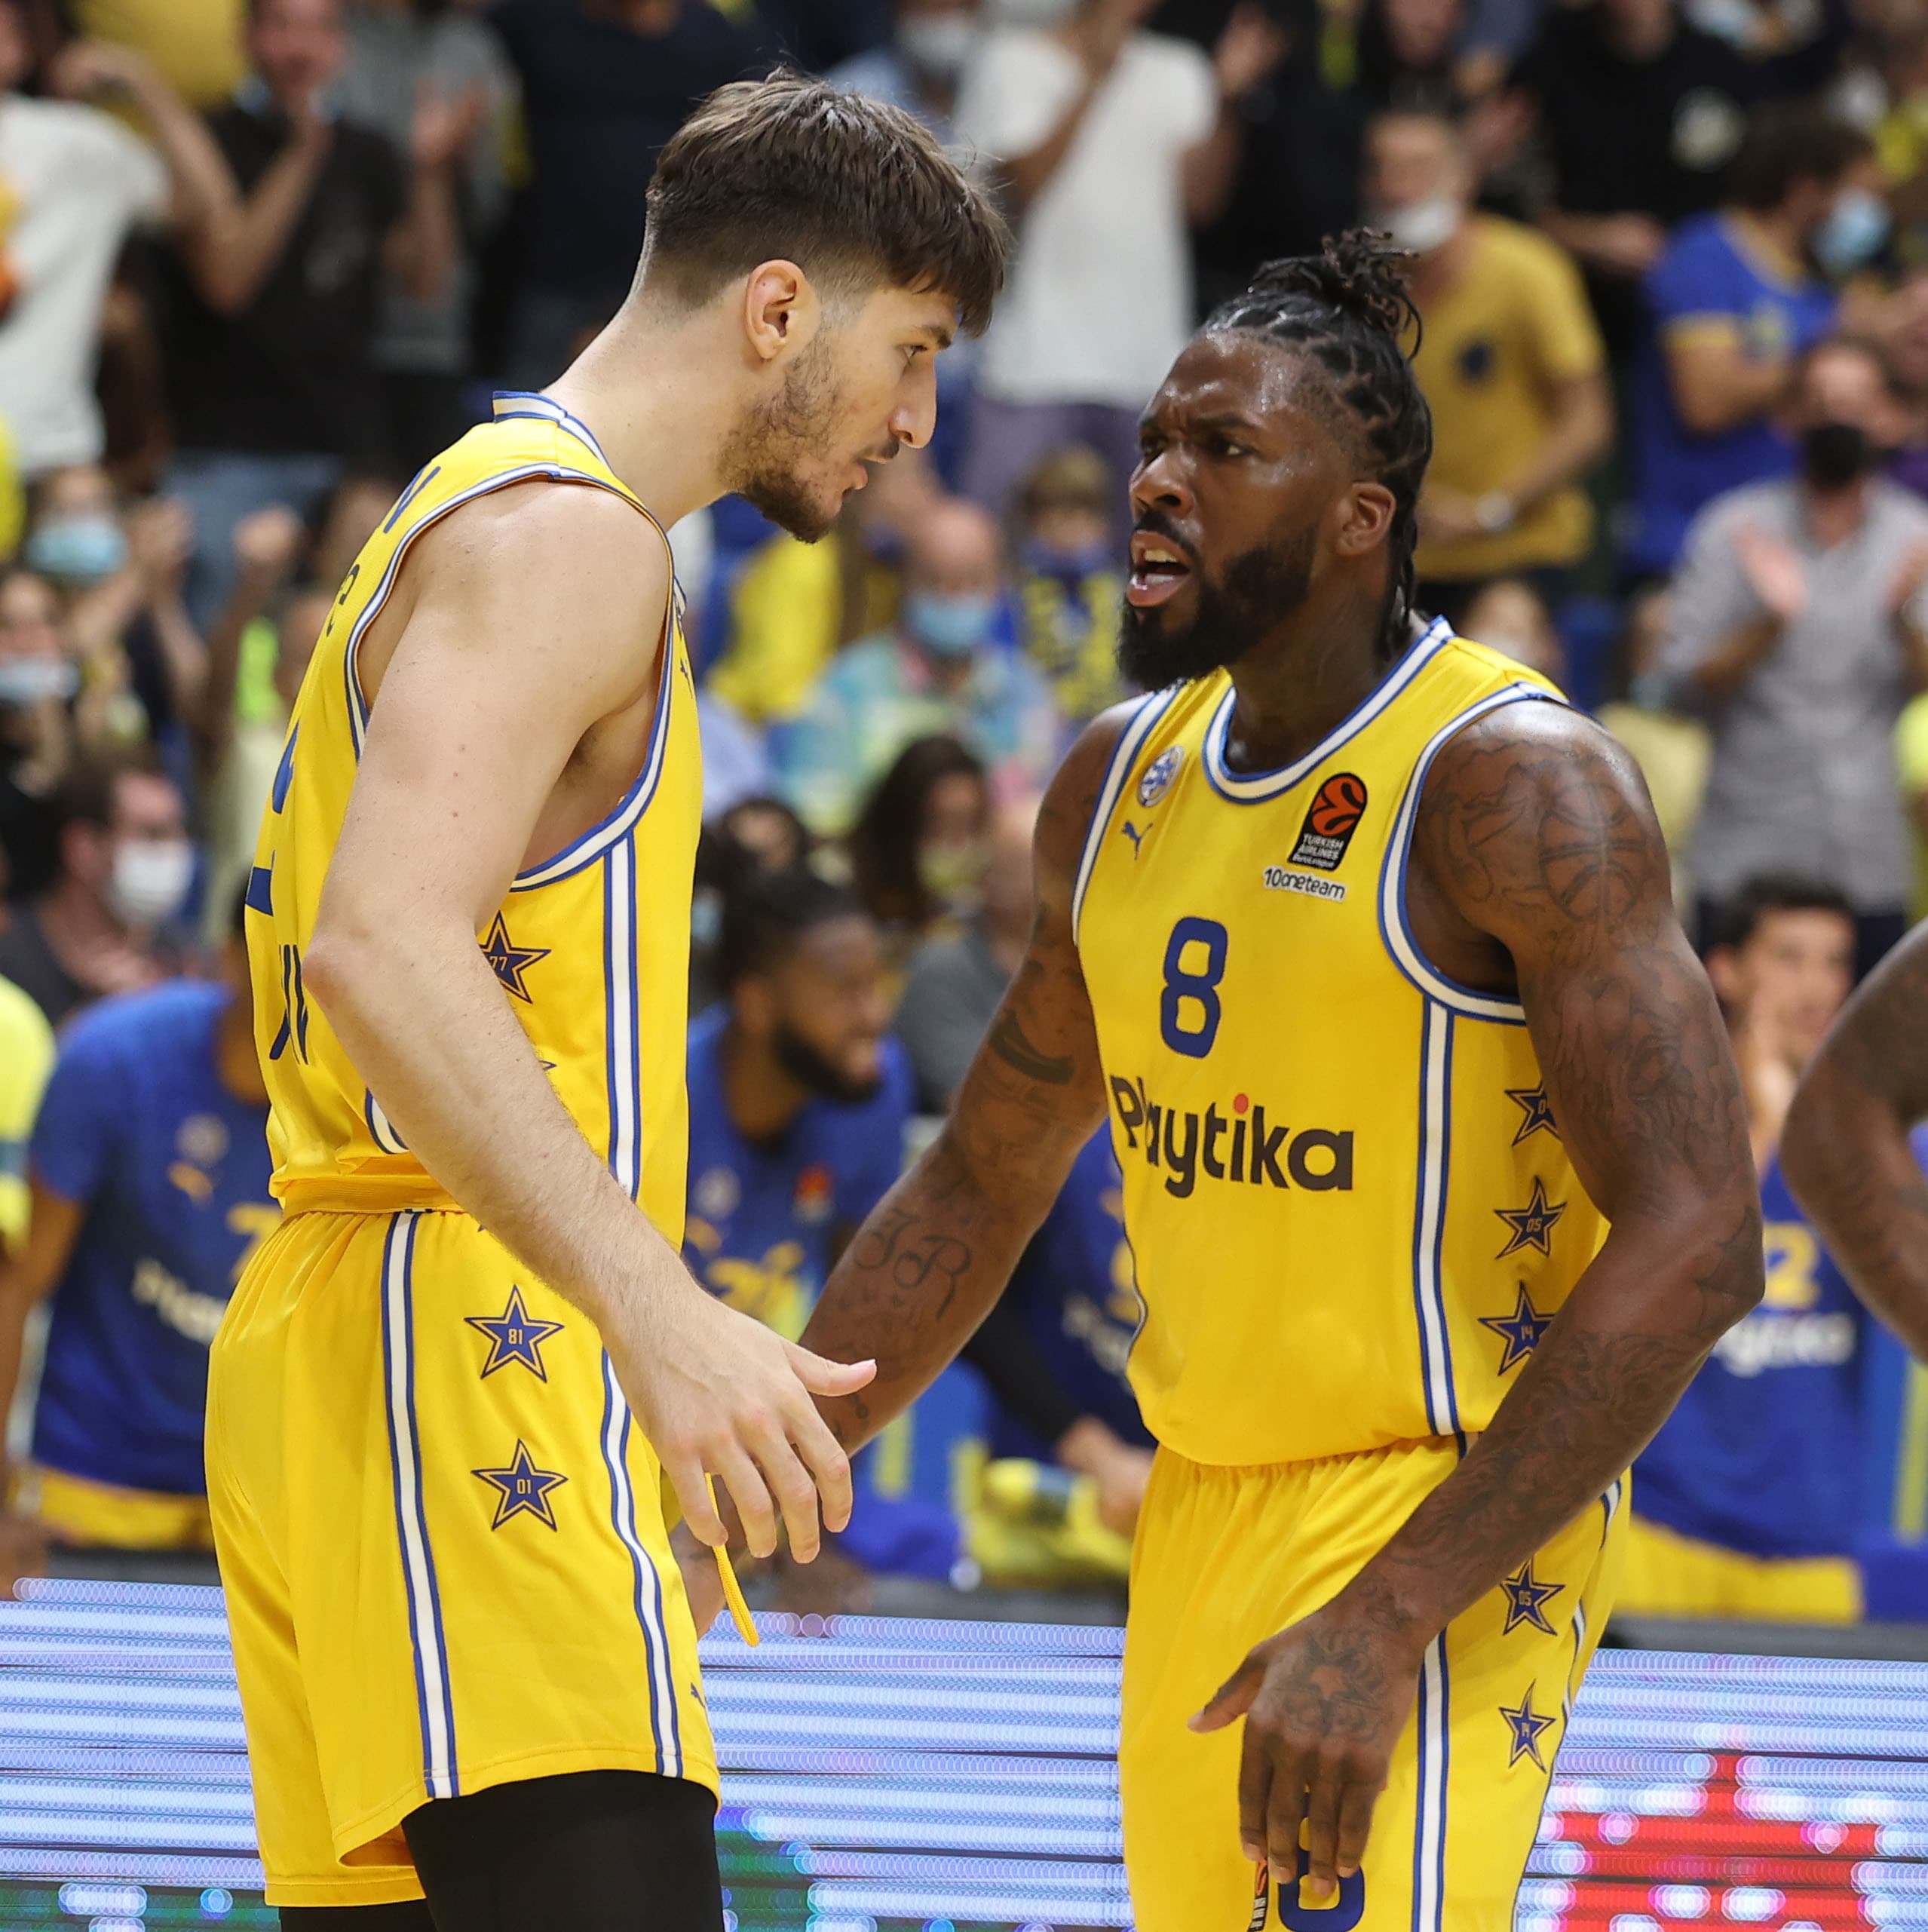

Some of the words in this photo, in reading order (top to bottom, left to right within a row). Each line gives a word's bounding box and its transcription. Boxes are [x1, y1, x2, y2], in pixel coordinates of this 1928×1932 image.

[1303, 833, 1344, 848] TURKISH
[1298, 845, 1340, 860] AIRLINES
[489, 955, 508, 971] 77
[1160, 916, 1228, 1058] 8
[1526, 1218, 1543, 1233] 05
[508, 1328, 523, 1345] 81
[1521, 1325, 1534, 1341] 14
[516, 1479, 532, 1495] 01
